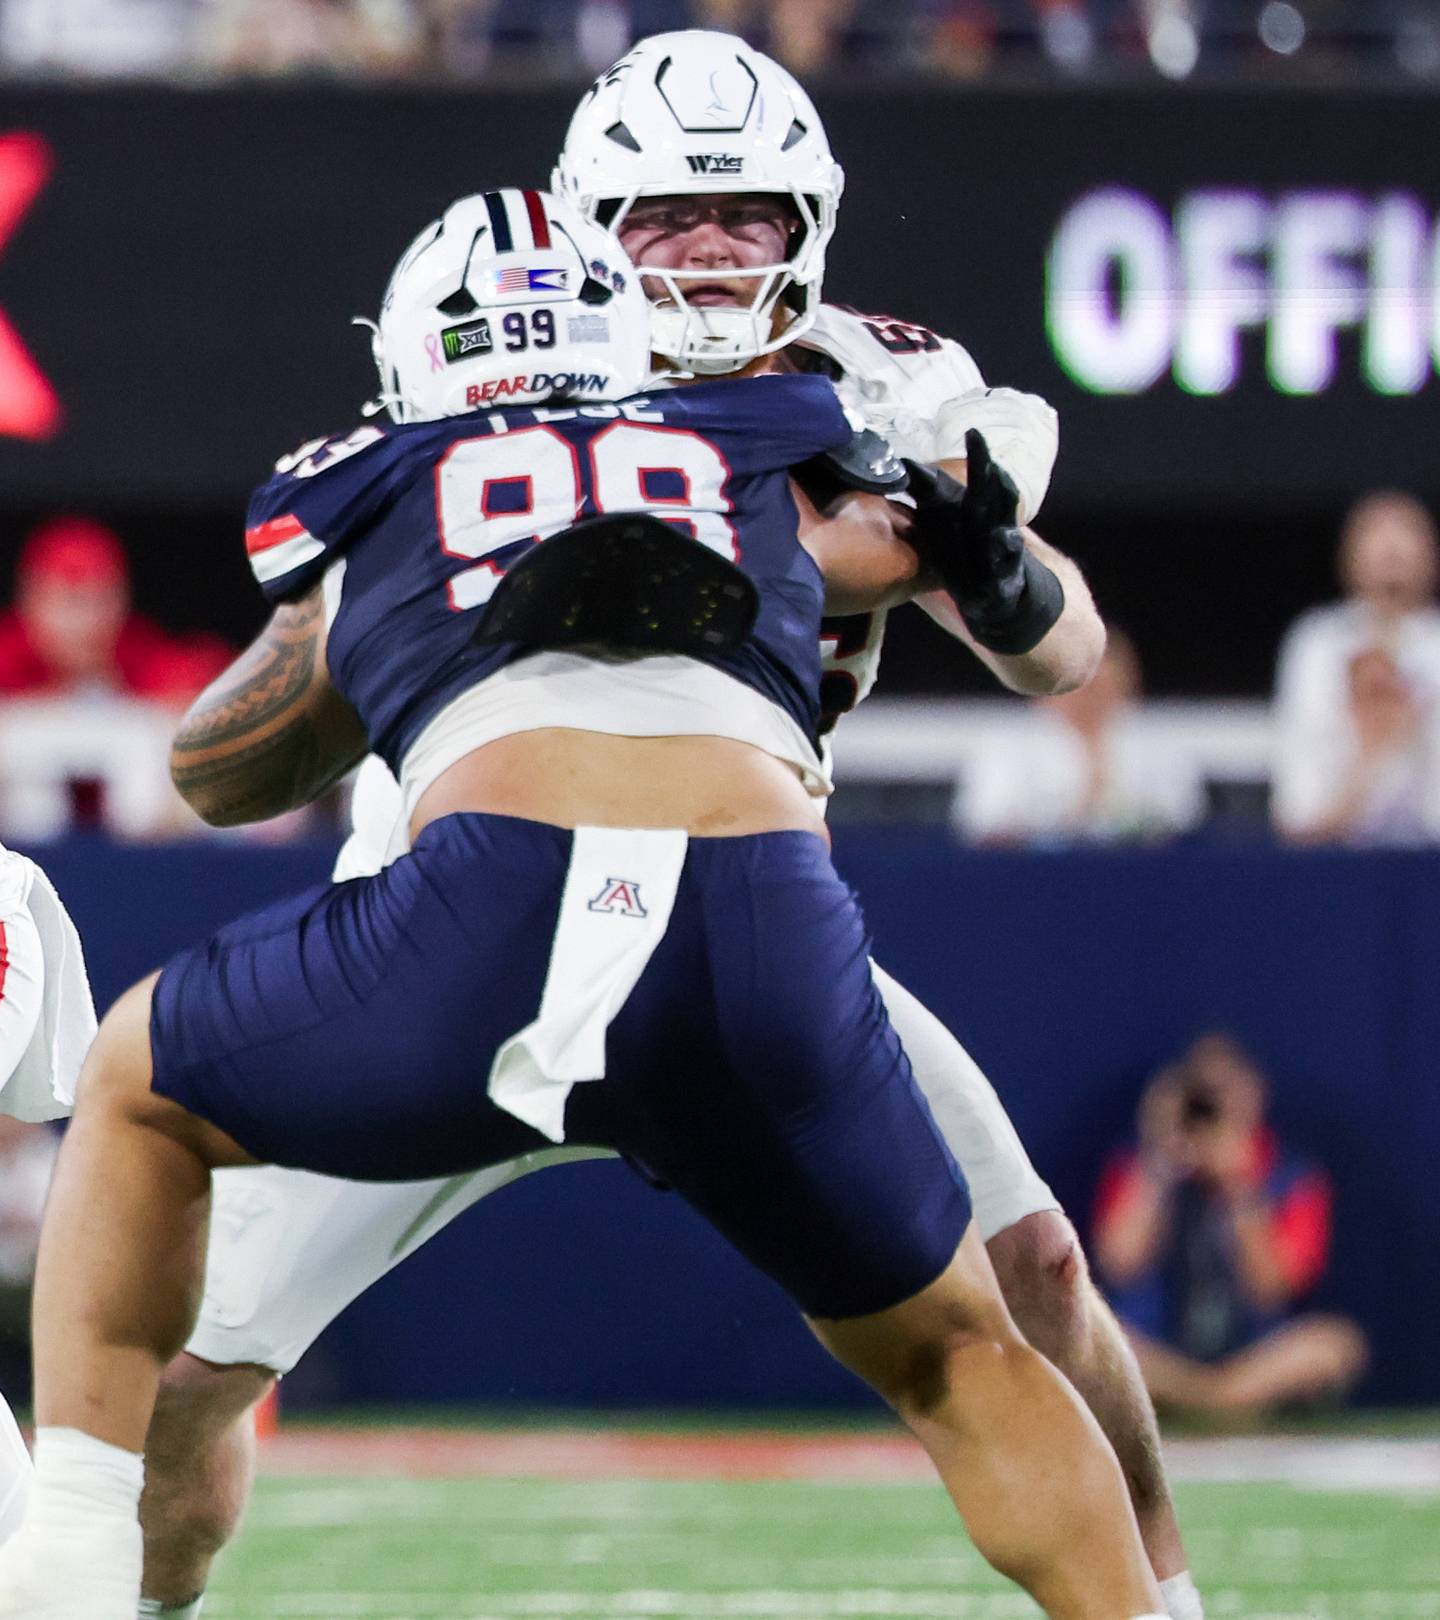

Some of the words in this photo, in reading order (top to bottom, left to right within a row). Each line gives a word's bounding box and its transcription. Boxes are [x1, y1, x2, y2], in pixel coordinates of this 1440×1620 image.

[1045, 182, 1440, 396] OFFI
[503, 309, 556, 351] 99
[587, 878, 647, 918] A
